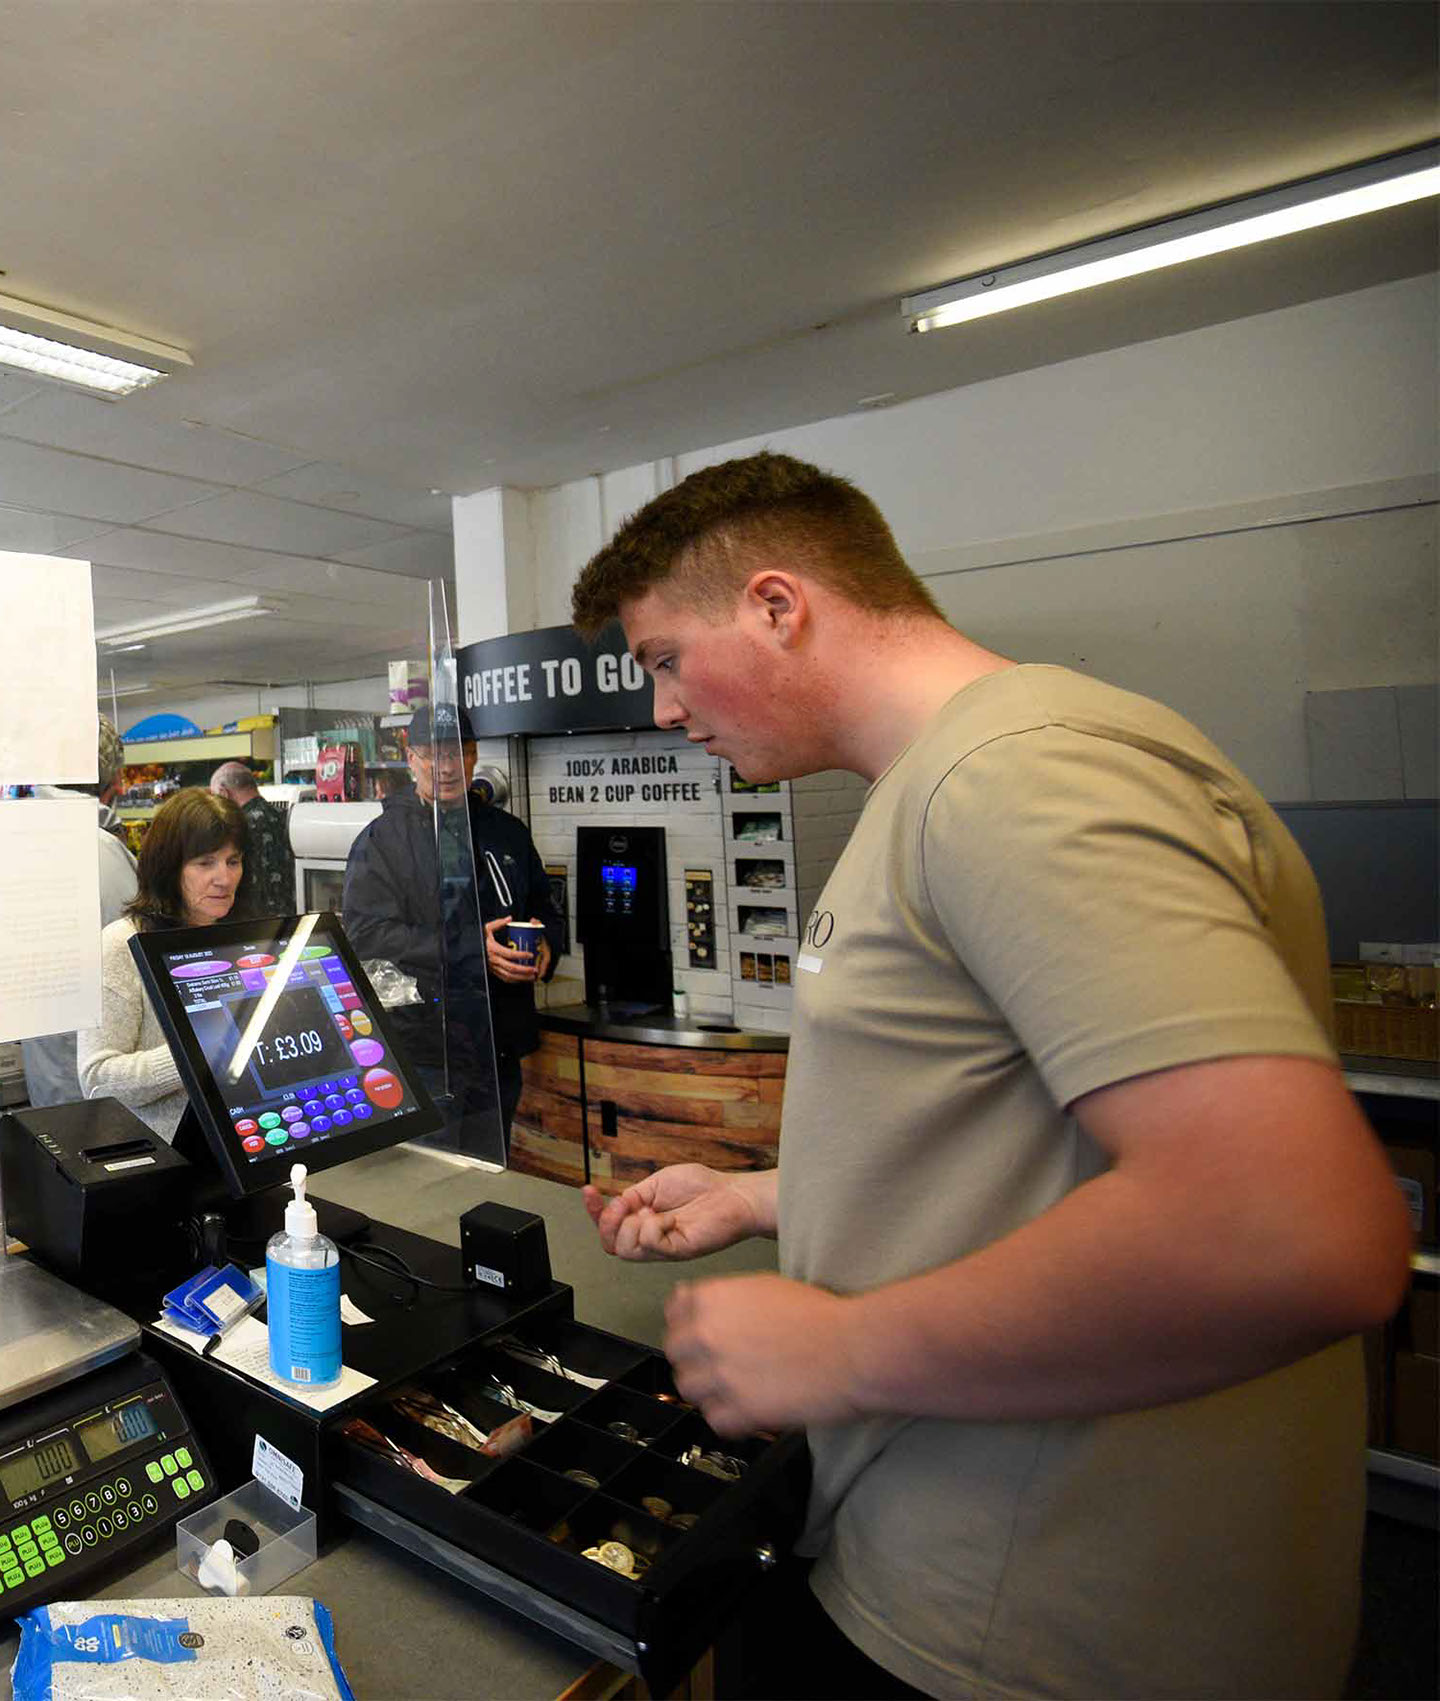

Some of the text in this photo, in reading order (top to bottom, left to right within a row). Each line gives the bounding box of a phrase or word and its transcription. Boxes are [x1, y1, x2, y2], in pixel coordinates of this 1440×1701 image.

[464, 652, 645, 708] COFFEE TO GO
[566, 756, 678, 777] 100% ARABICA
[549, 783, 700, 803] BEAN 2 CUP COFFEE
[275, 1030, 322, 1061] £3.09
[58, 1483, 127, 1524] 5 6 7 8 9
[116, 1514, 125, 1525] 2
[132, 1507, 139, 1516] 3
[146, 1499, 153, 1509] 4
